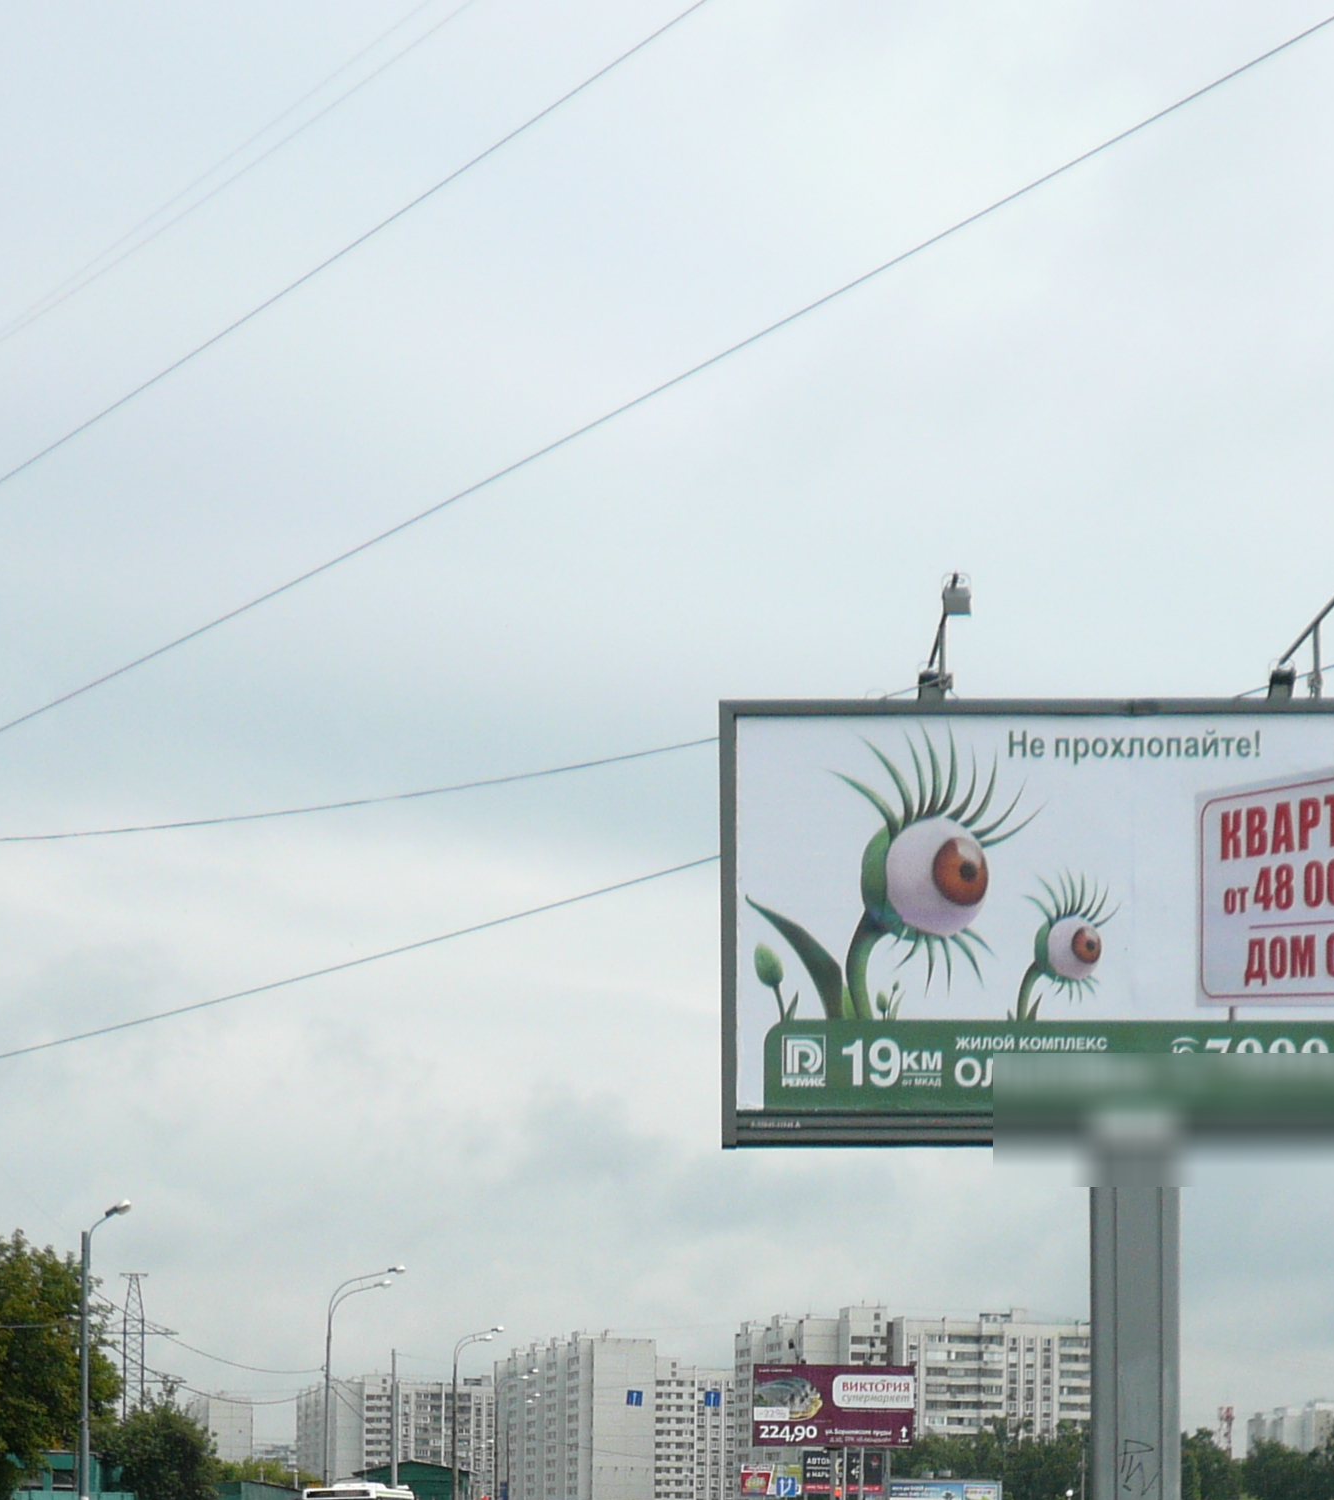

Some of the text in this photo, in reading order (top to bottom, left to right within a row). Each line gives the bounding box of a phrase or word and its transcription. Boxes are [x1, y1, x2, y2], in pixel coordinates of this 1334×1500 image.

[1007, 728, 1261, 765] Не прохлопайте!
[1253, 863, 1295, 912] 48
[1244, 934, 1317, 987] ДОМ
[955, 1034, 1108, 1050] ЖИЛОЙ КОМПЛЕКС
[842, 1038, 901, 1088] 19
[914, 1077, 942, 1087] МКАД
[842, 1380, 910, 1392] ВИКТОРИЯ
[842, 1394, 910, 1404] супермаркет
[759, 1425, 817, 1442] 224,90
